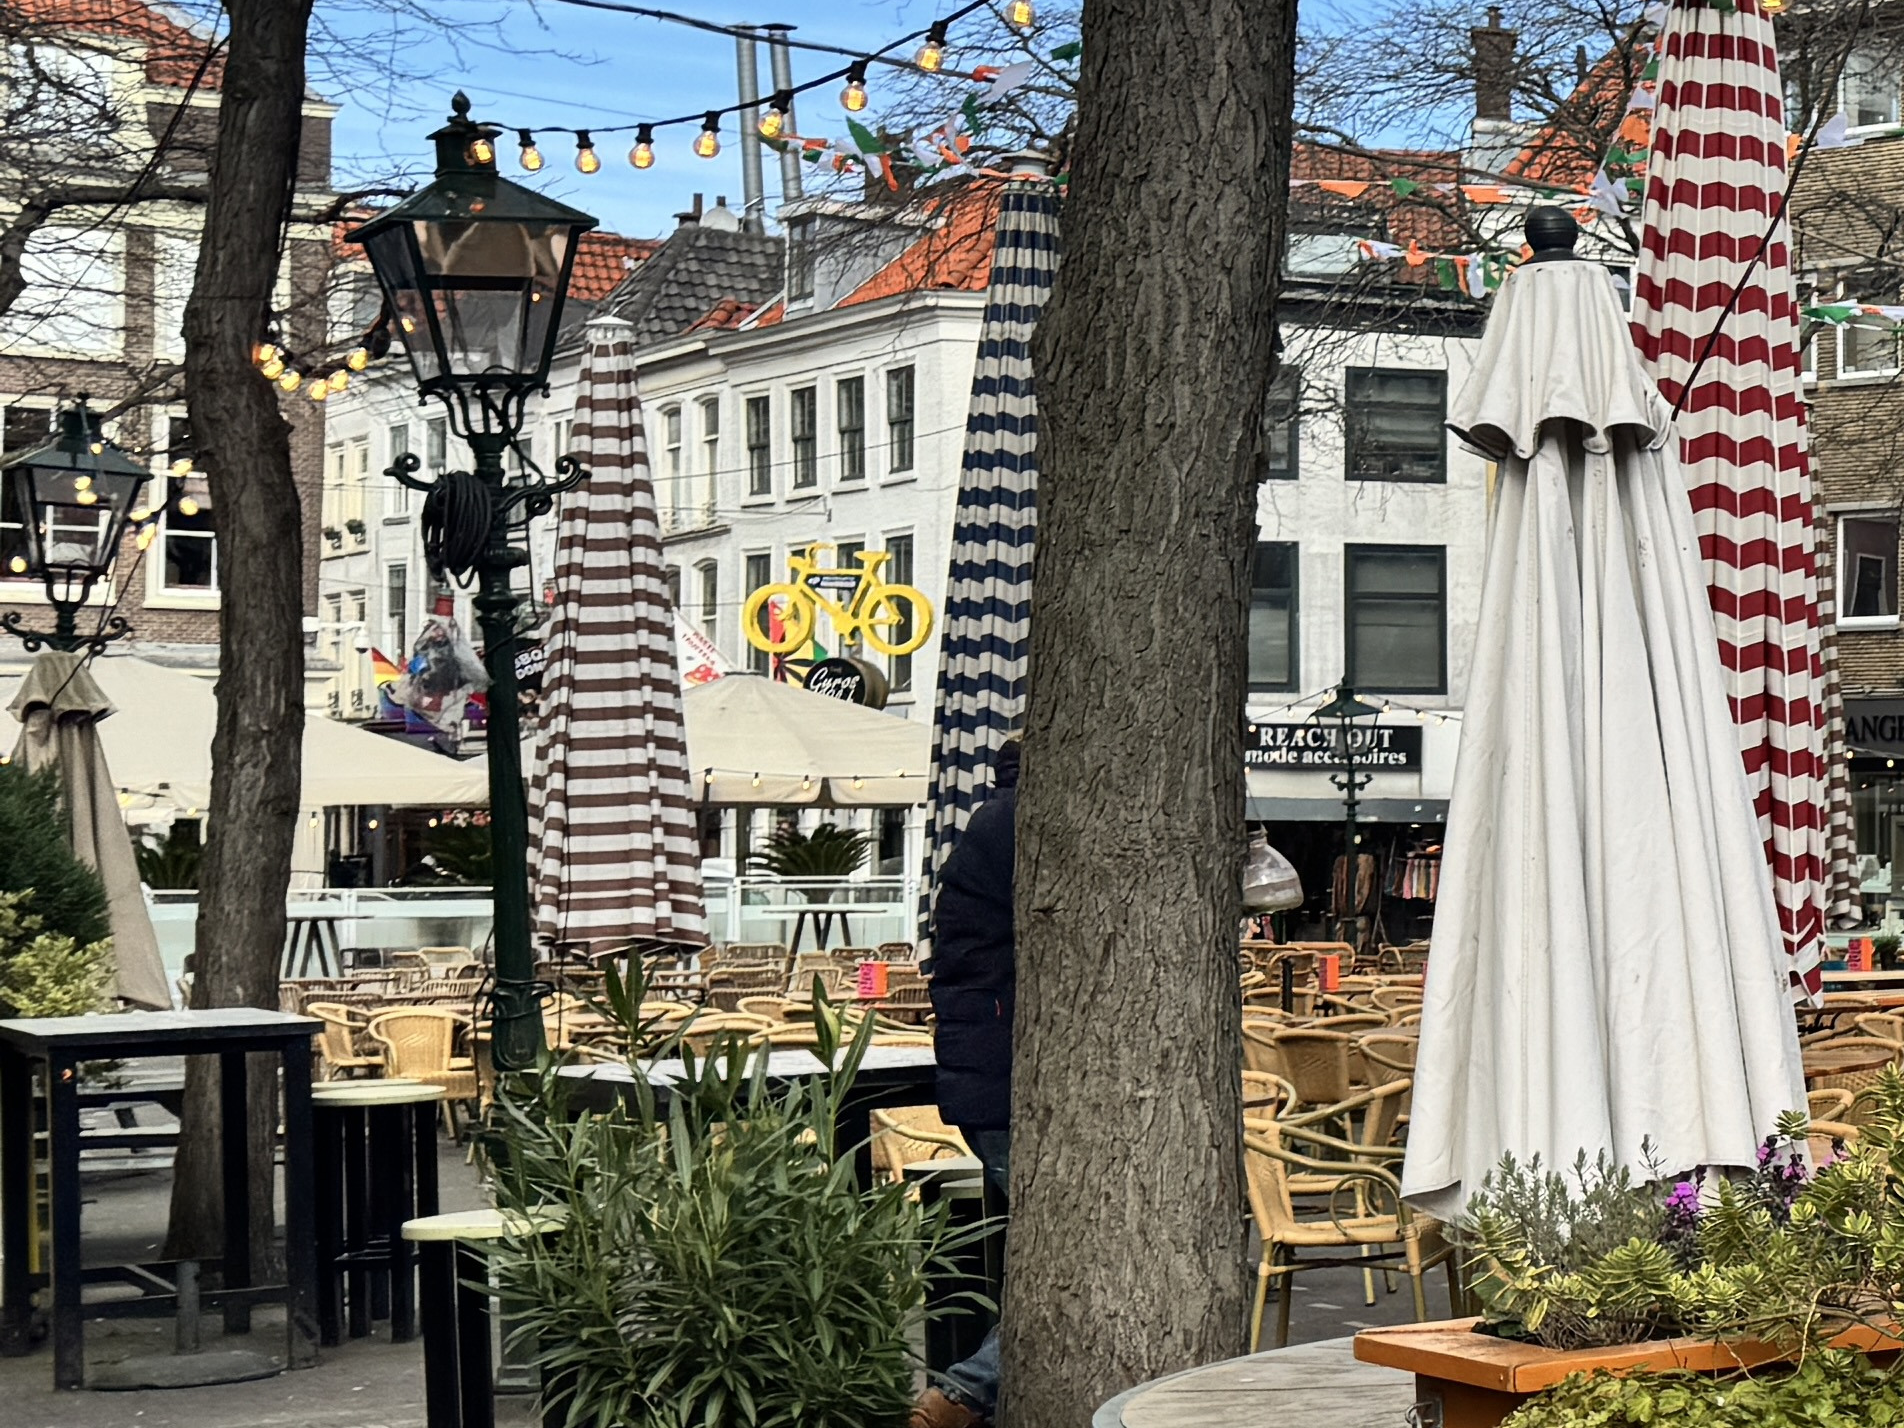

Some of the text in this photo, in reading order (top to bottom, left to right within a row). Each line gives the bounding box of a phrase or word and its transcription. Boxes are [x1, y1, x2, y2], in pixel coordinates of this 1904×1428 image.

[1259, 726, 1394, 749] REACH OUT
[1244, 747, 1298, 764] mode
